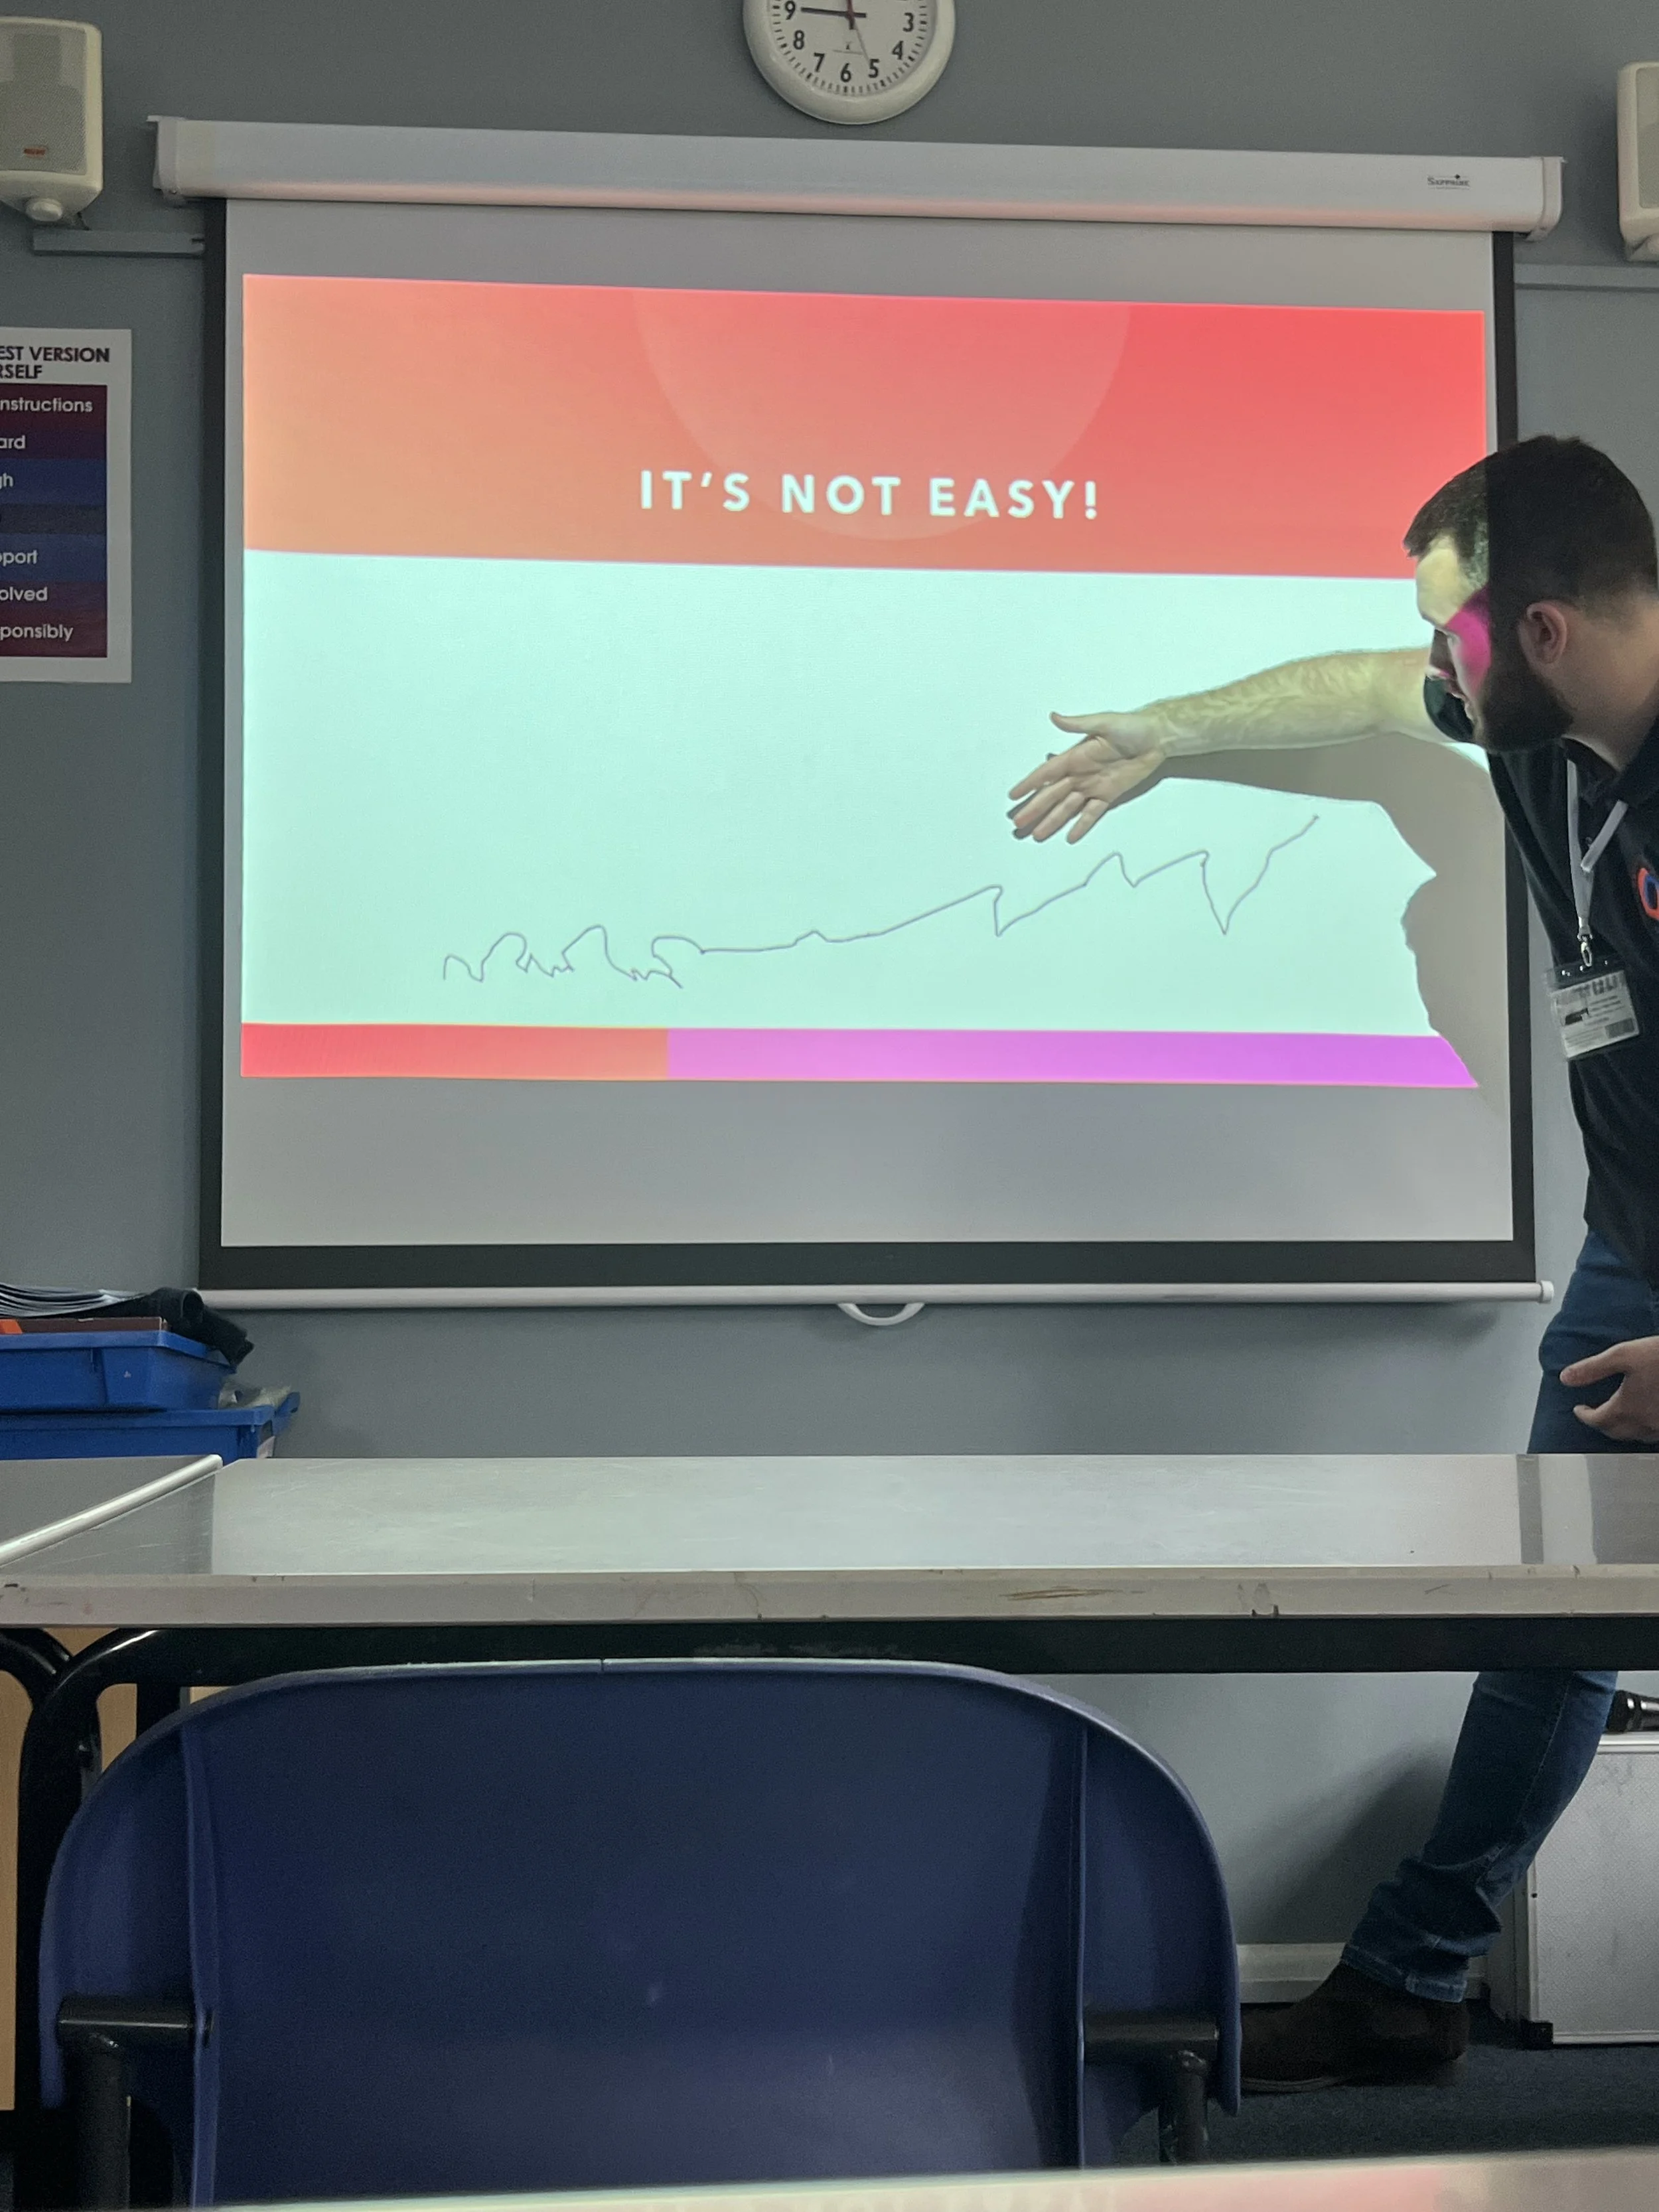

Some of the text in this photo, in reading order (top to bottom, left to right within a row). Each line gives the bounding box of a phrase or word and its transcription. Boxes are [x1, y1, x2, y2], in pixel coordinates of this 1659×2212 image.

[784, 1, 796, 20] 9
[902, 13, 914, 32] 3
[794, 30, 804, 50] 8
[892, 40, 903, 60] 4
[814, 52, 825, 72] 7
[868, 58, 879, 78] 5
[840, 63, 851, 82] 6
[29, 346, 109, 362] VERSION
[0, 398, 93, 412] nstructions
[641, 470, 1098, 520] IT'S NOT EASY!
[0, 550, 38, 567] port
[0, 624, 74, 642] ponsibly
